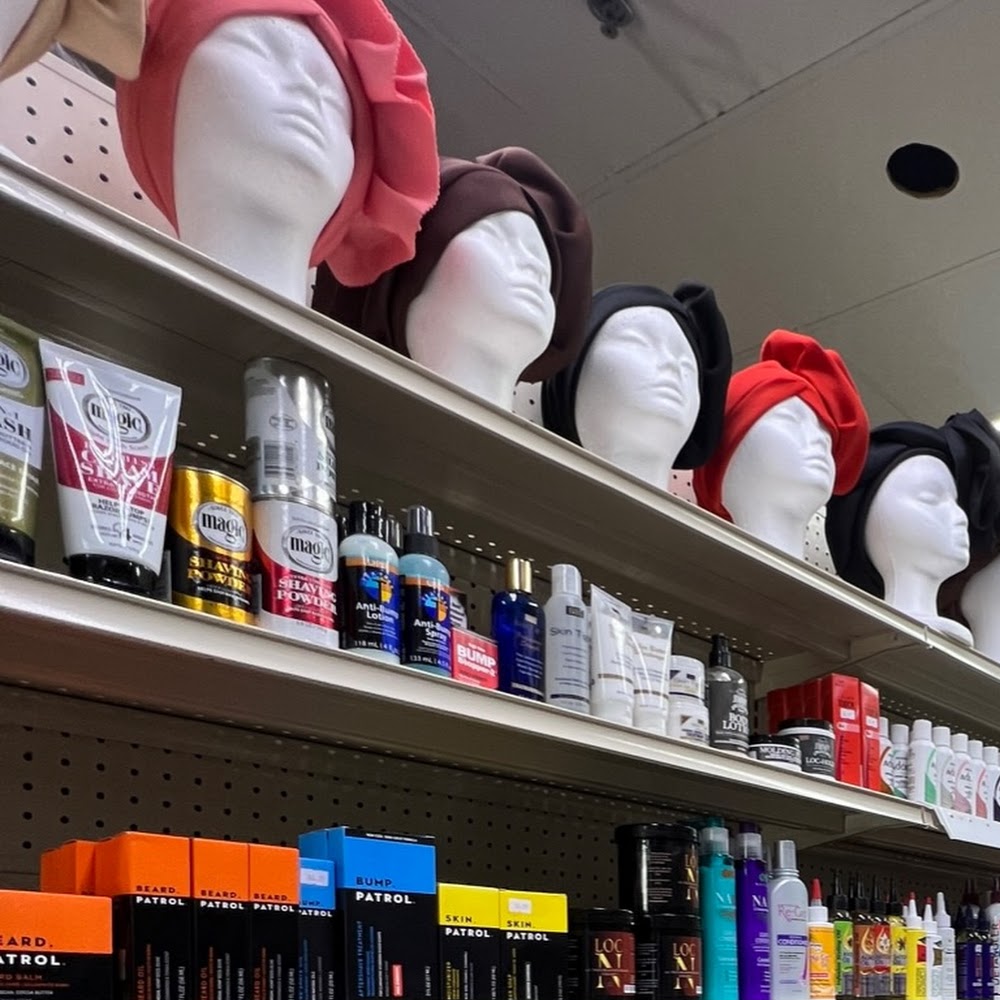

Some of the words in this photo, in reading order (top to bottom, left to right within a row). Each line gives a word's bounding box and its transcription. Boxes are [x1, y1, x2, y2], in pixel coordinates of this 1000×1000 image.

[202, 512, 245, 544] magic
[290, 536, 329, 565] magic
[551, 627, 572, 637] Skin
[457, 644, 496, 668] BUMP
[357, 877, 392, 888] BUMP
[136, 896, 184, 906] PATROL
[356, 891, 412, 904] PATROL
[200, 901, 244, 910] PATROL
[253, 903, 295, 912] PATROL
[445, 927, 490, 938] PATROL
[506, 932, 549, 941] PATROL
[595, 938, 622, 952] LOC
